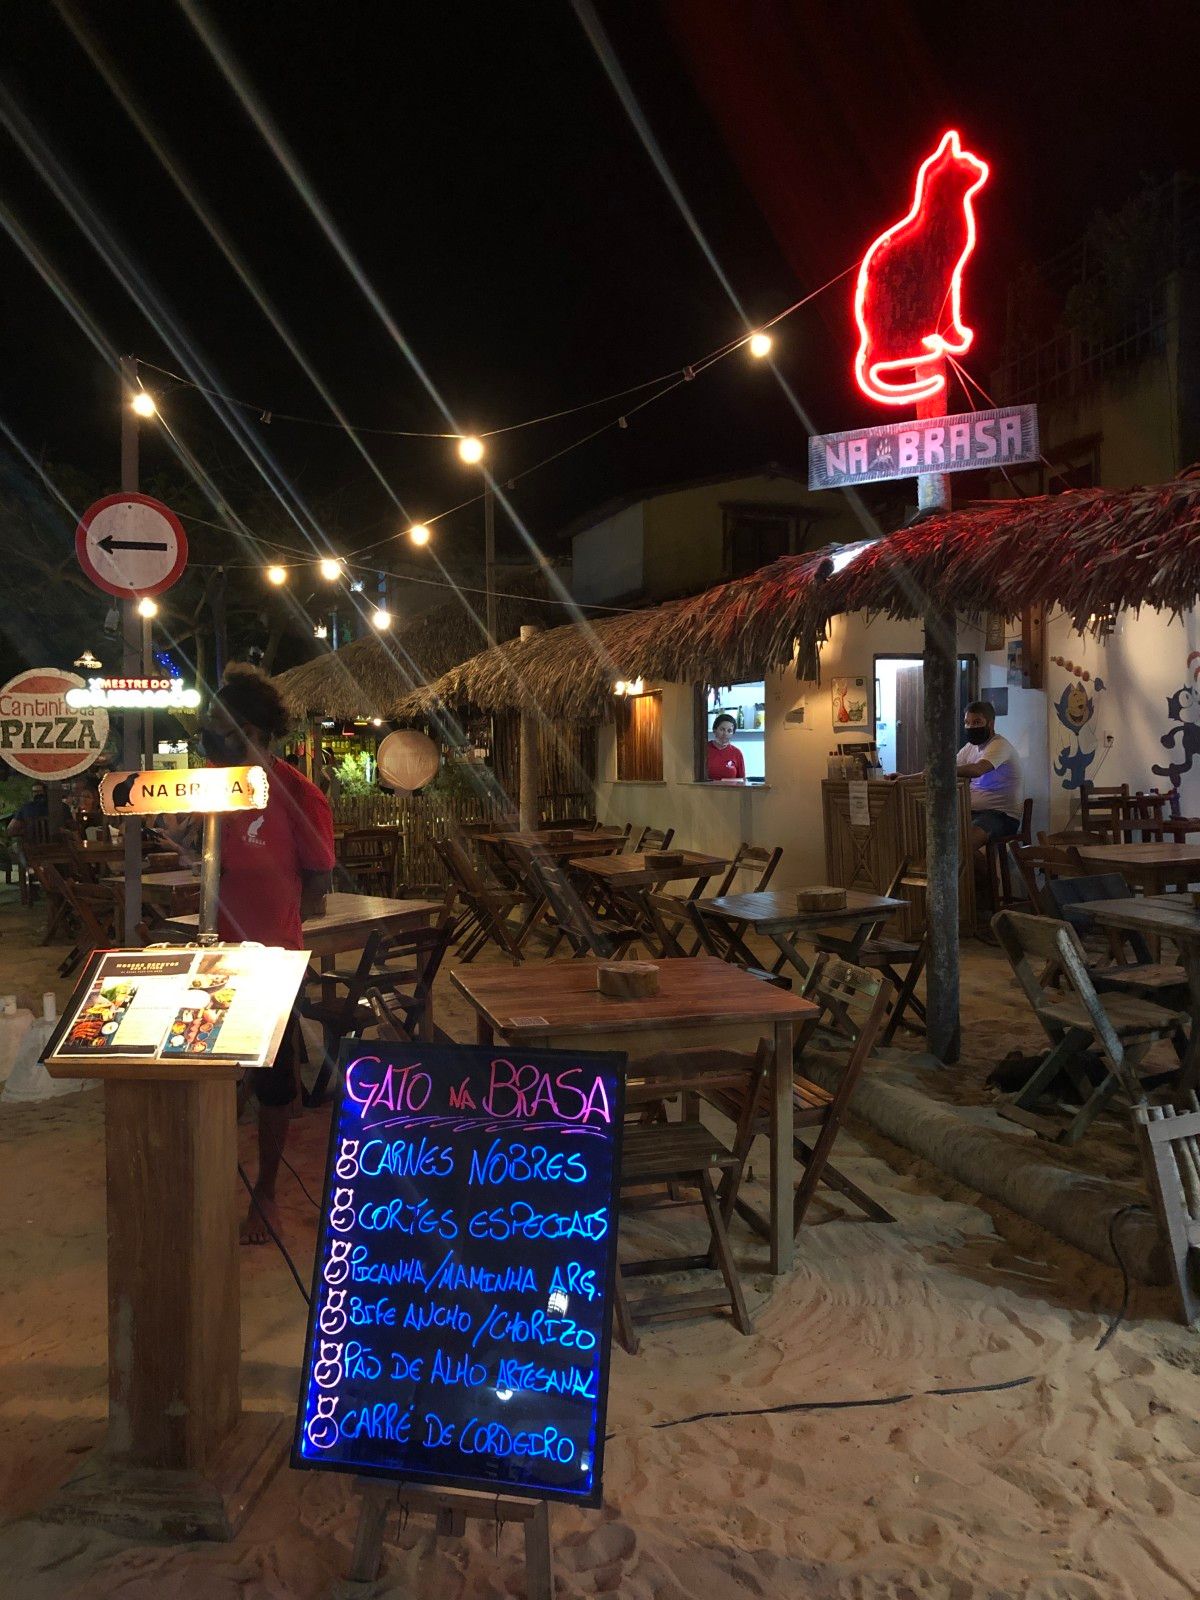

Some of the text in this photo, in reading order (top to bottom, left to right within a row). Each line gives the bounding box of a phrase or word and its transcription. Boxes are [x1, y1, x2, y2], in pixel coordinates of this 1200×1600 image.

[826, 415, 1022, 476] NA BRASA
[101, 679, 170, 689] MESTRE DO
[0, 717, 100, 749] PIZZA
[142, 781, 243, 797] NA BRA
[346, 1056, 611, 1123] GATO NA BRASA
[358, 1137, 588, 1186] CARNES NOBRES
[358, 1198, 608, 1241] CORTES ESPECIAIS
[548, 1261, 602, 1301] ARG.
[349, 1296, 397, 1326] BIFE
[402, 1302, 471, 1331] ANCHO
[343, 1341, 597, 1399] PÃO DE ALHO ARTESANAL
[339, 1402, 575, 1464] CARRÉ DE CORDEIRO
